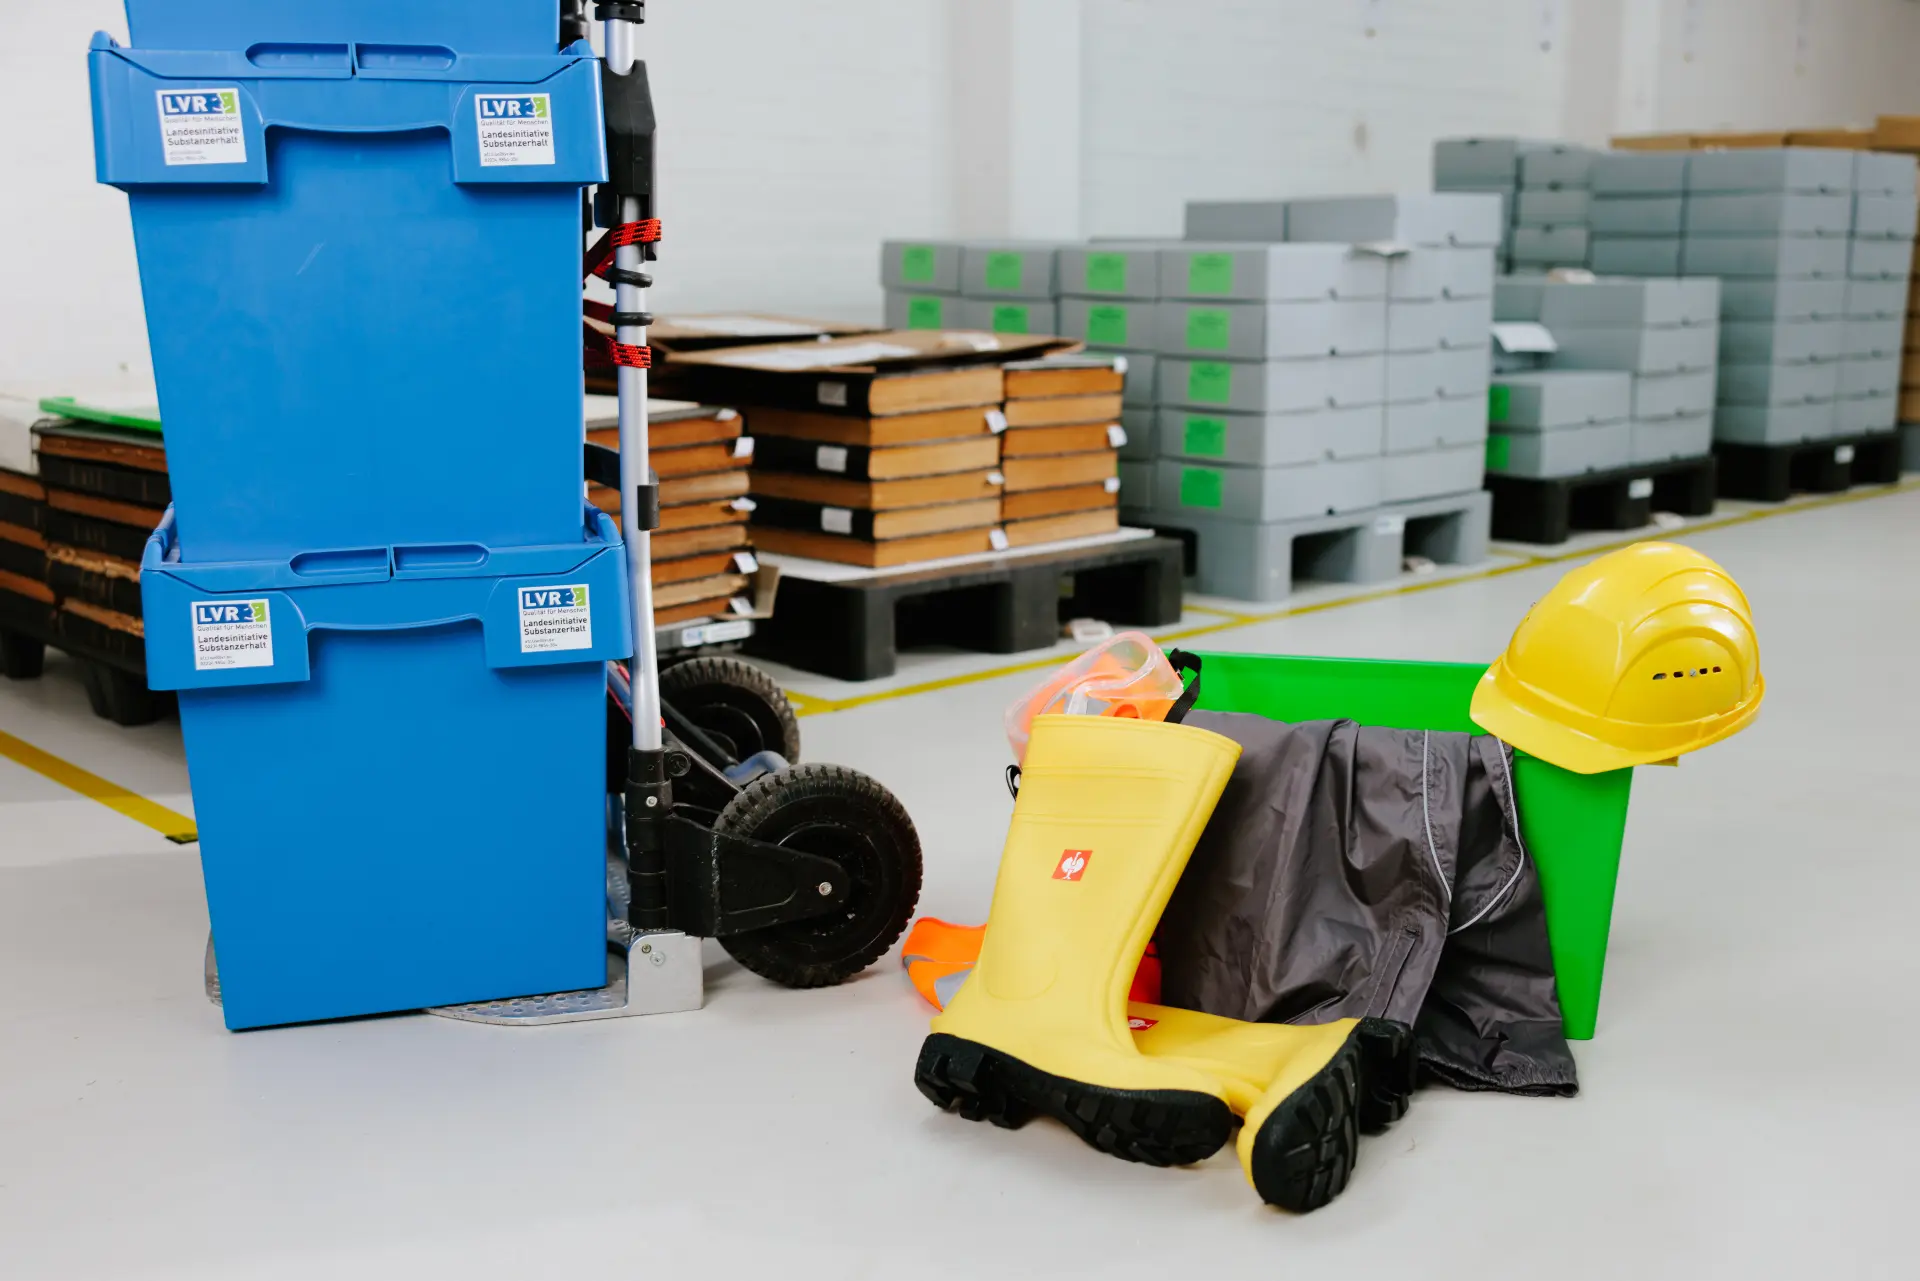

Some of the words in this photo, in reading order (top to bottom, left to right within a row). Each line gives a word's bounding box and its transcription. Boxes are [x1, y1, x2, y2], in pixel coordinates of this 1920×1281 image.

[164, 95, 208, 113] LVR
[482, 100, 522, 116] LVR
[166, 127, 239, 137] Landesinitiative
[482, 130, 549, 138] Landesinitiative
[167, 136, 239, 146] Substanzerhalt
[483, 139, 548, 148] Substanzerhalt
[525, 591, 562, 607] LVR
[199, 606, 240, 622] LVR
[524, 617, 587, 627] Landesinitiative
[524, 625, 586, 636] Substanzerhalt
[198, 633, 268, 643] Landesinitiative
[199, 642, 267, 652] Substanzerhalt
